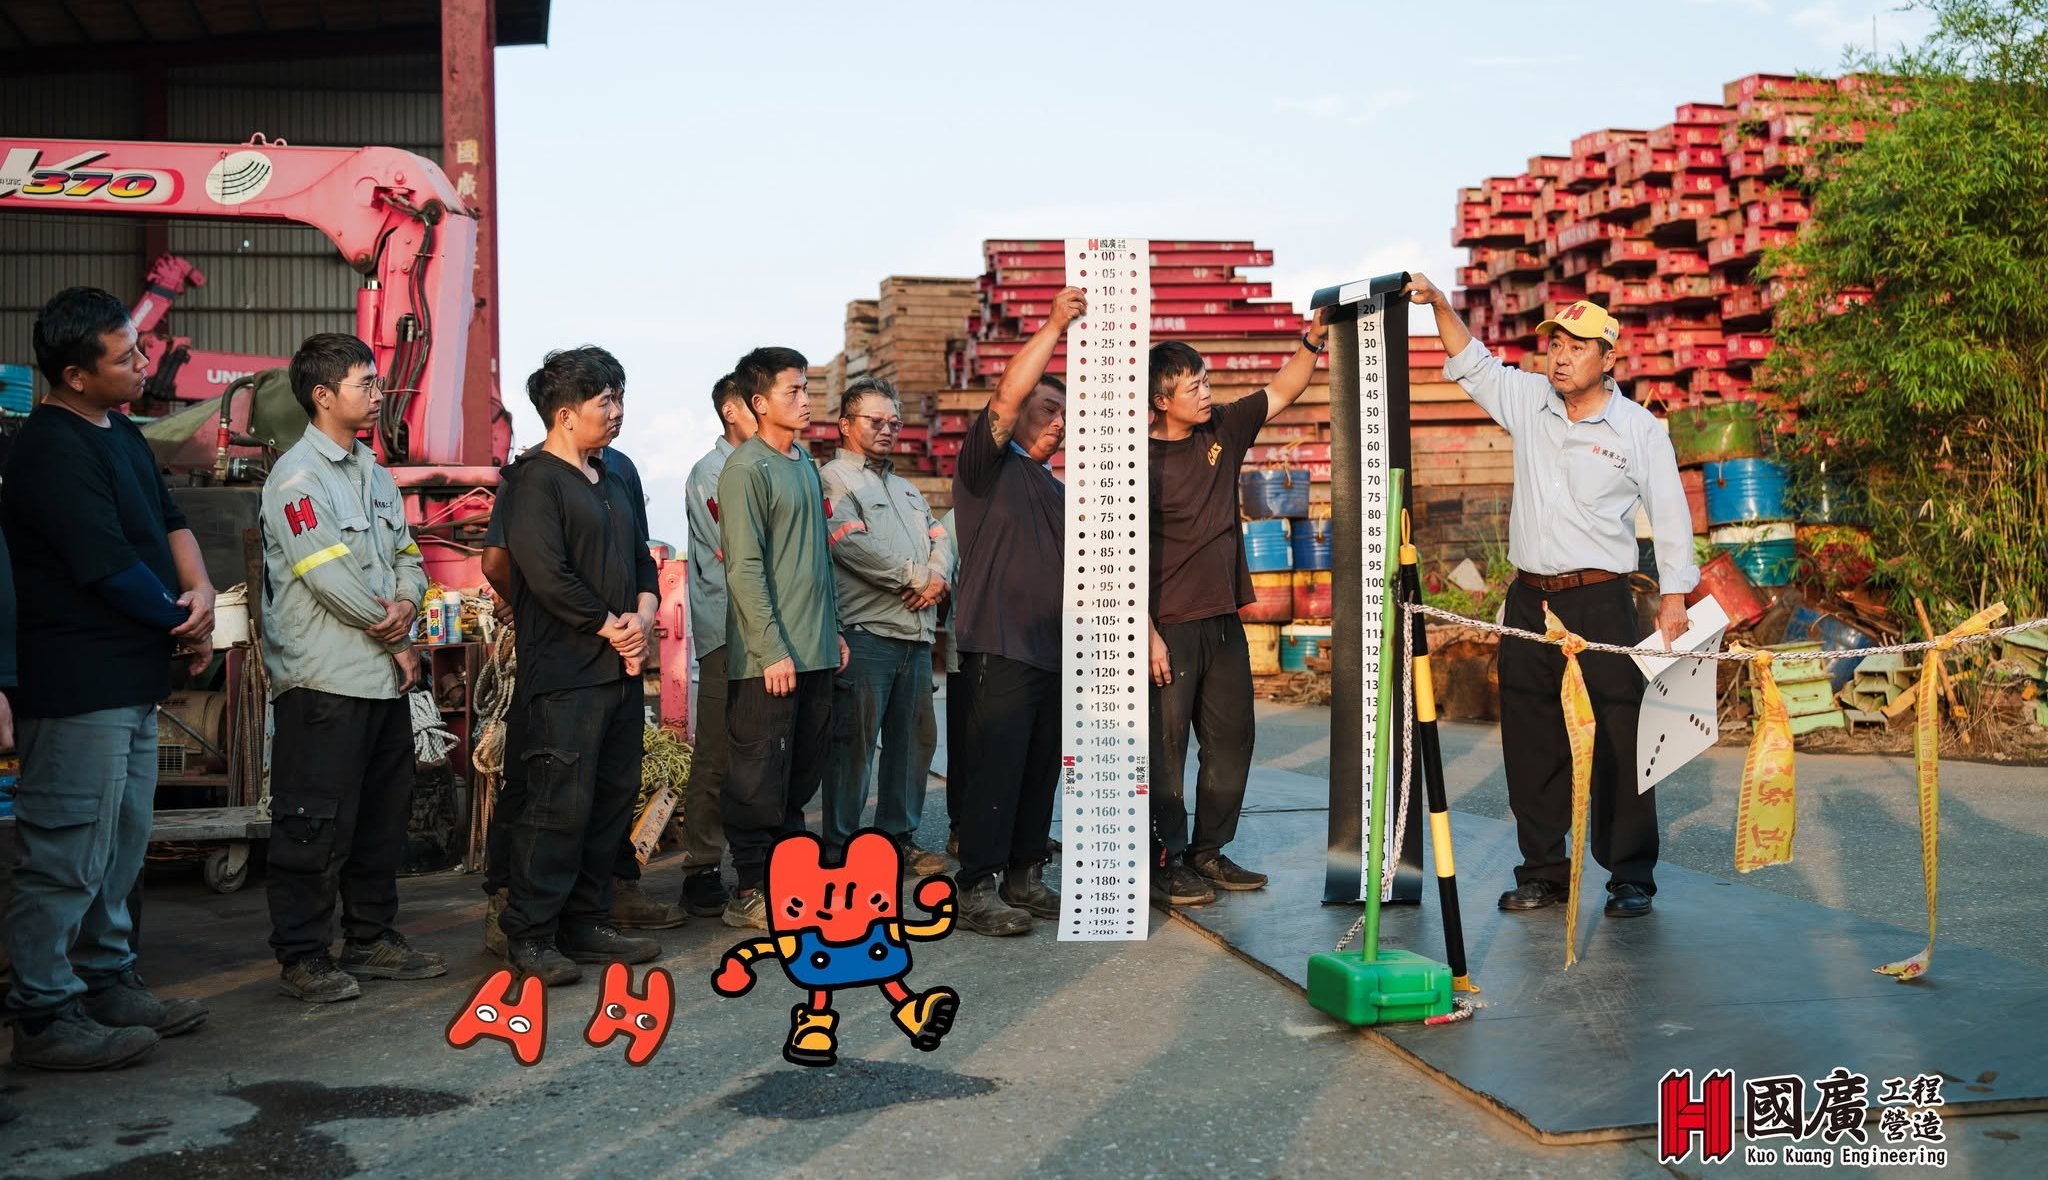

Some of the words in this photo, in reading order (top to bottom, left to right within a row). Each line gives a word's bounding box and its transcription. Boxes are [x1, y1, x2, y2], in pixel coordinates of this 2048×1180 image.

[22, 170, 157, 198] 370
[1102, 252, 1115, 261] 00
[1102, 268, 1115, 278] 05
[1102, 286, 1115, 296] 10
[1102, 304, 1115, 313] 15
[1363, 304, 1376, 314] 20
[1102, 321, 1115, 331] 20
[1363, 322, 1375, 331] 25
[1102, 339, 1115, 348] 25
[1364, 339, 1376, 348] 30
[1102, 356, 1115, 366] 30
[1365, 356, 1377, 365] 35
[1100, 374, 1114, 383] 35
[1365, 373, 1378, 382] 40
[1100, 391, 1114, 401] 40
[1366, 390, 1379, 399] 45
[1100, 408, 1114, 418] 45
[1366, 407, 1379, 418] 50
[1100, 426, 1114, 435] 50
[1366, 424, 1379, 434] 55
[1100, 443, 1114, 453] 55
[1367, 441, 1380, 452] 60
[1207, 442, 1223, 467] CAT
[1100, 461, 1114, 470] 60
[1367, 459, 1380, 468] 65
[1100, 478, 1114, 488] 65
[1367, 476, 1380, 486] 70
[1100, 495, 1114, 505] 70
[1368, 493, 1380, 502] 75
[284, 496, 318, 537] H
[1100, 512, 1114, 523] 75
[1368, 510, 1381, 520] 80
[1100, 529, 1114, 540] 80
[1368, 527, 1381, 536] 85
[1100, 547, 1114, 557] 85
[1368, 544, 1381, 554] 90
[1100, 564, 1114, 574] 90
[1369, 561, 1382, 570] 95
[1100, 582, 1114, 591] 95
[1365, 578, 1384, 588] 100
[1096, 599, 1116, 608] 100
[1096, 616, 1116, 625] 105
[1096, 633, 1116, 643] 110
[1096, 650, 1116, 660] 115
[1096, 667, 1116, 677] 120
[1096, 685, 1116, 694] 125
[1096, 702, 1116, 712] 130
[1096, 719, 1116, 729] 135
[1096, 737, 1116, 746] 140
[1096, 754, 1116, 764] 145
[1096, 771, 1116, 781] 150
[1096, 789, 1116, 799] 155
[1096, 807, 1116, 816] 160
[1096, 824, 1116, 834] 165
[1096, 842, 1116, 851] 170
[1096, 859, 1116, 869] 175
[1096, 876, 1116, 886] 180
[1095, 892, 1116, 901] 185
[1094, 907, 1115, 915] 190
